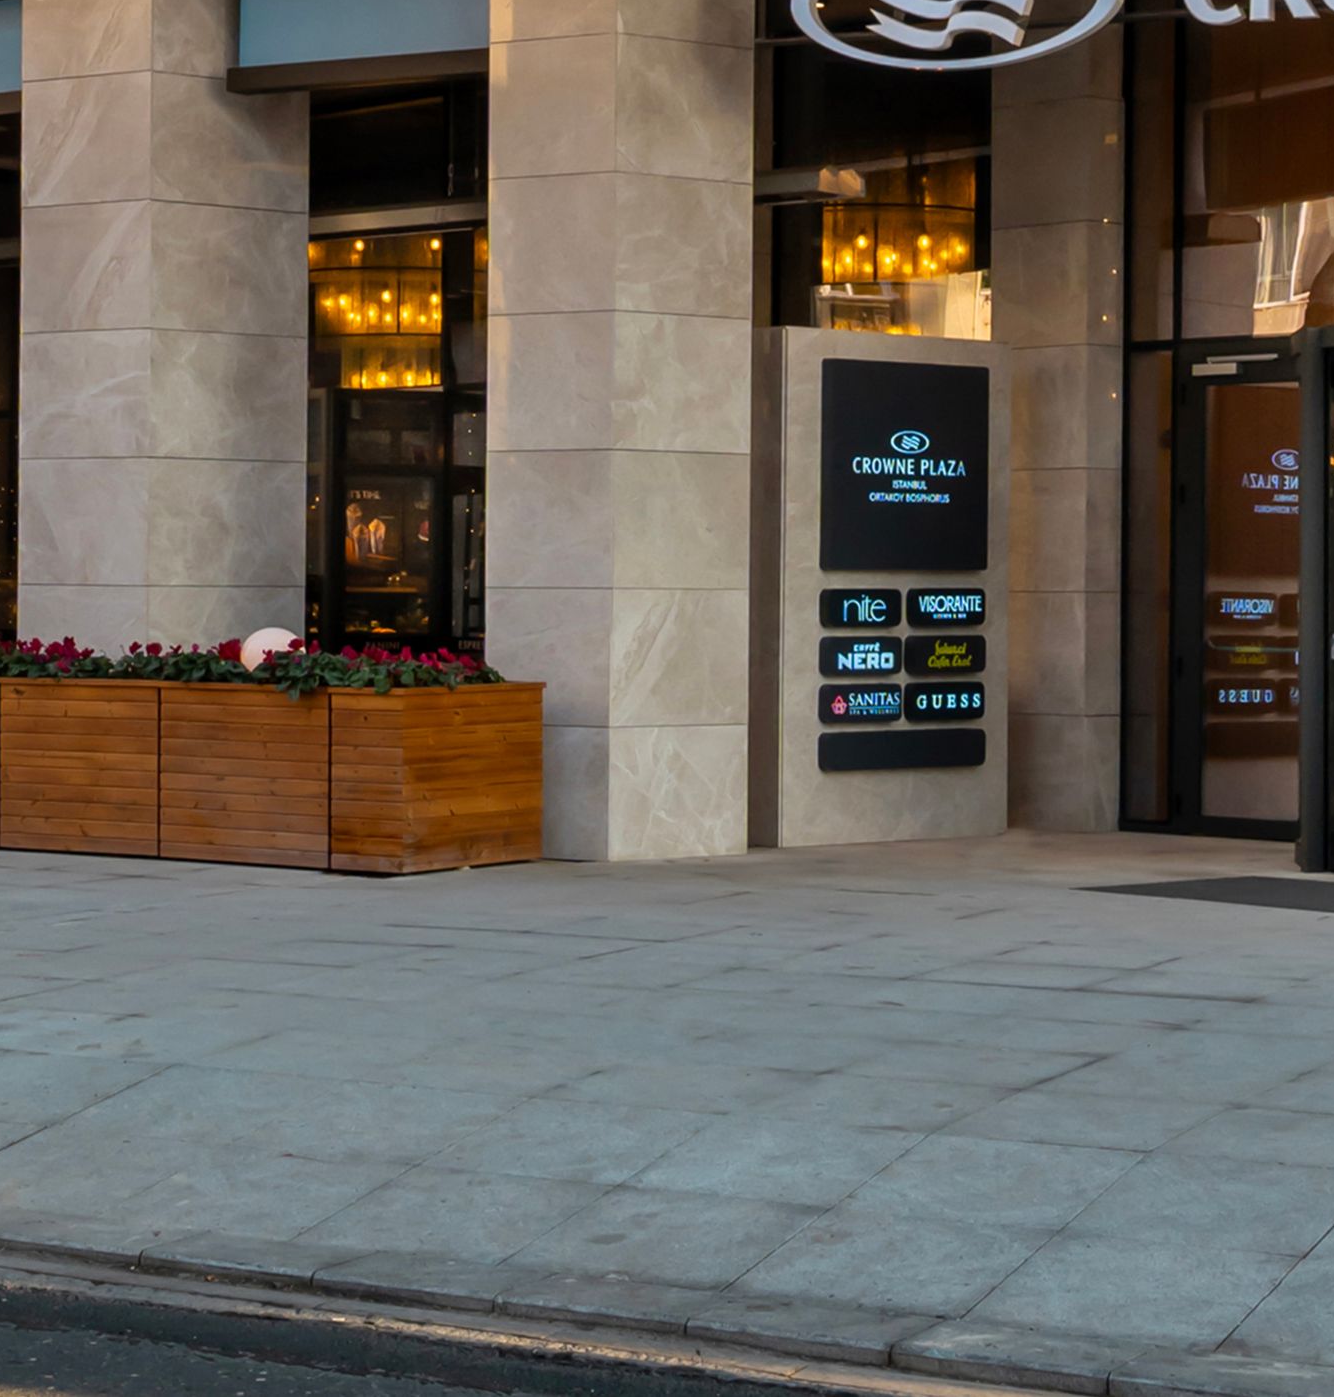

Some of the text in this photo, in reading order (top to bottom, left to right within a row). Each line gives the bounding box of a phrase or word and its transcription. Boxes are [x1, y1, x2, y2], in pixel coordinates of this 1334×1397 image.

[852, 457, 966, 476] CROWNE PLAZA
[905, 493, 950, 504] BOSPHORUS
[843, 594, 887, 622] nite
[918, 595, 983, 613] VISORANTE
[837, 652, 894, 671] NERO
[848, 692, 901, 707] SANITAS
[916, 693, 982, 710] GUESS
